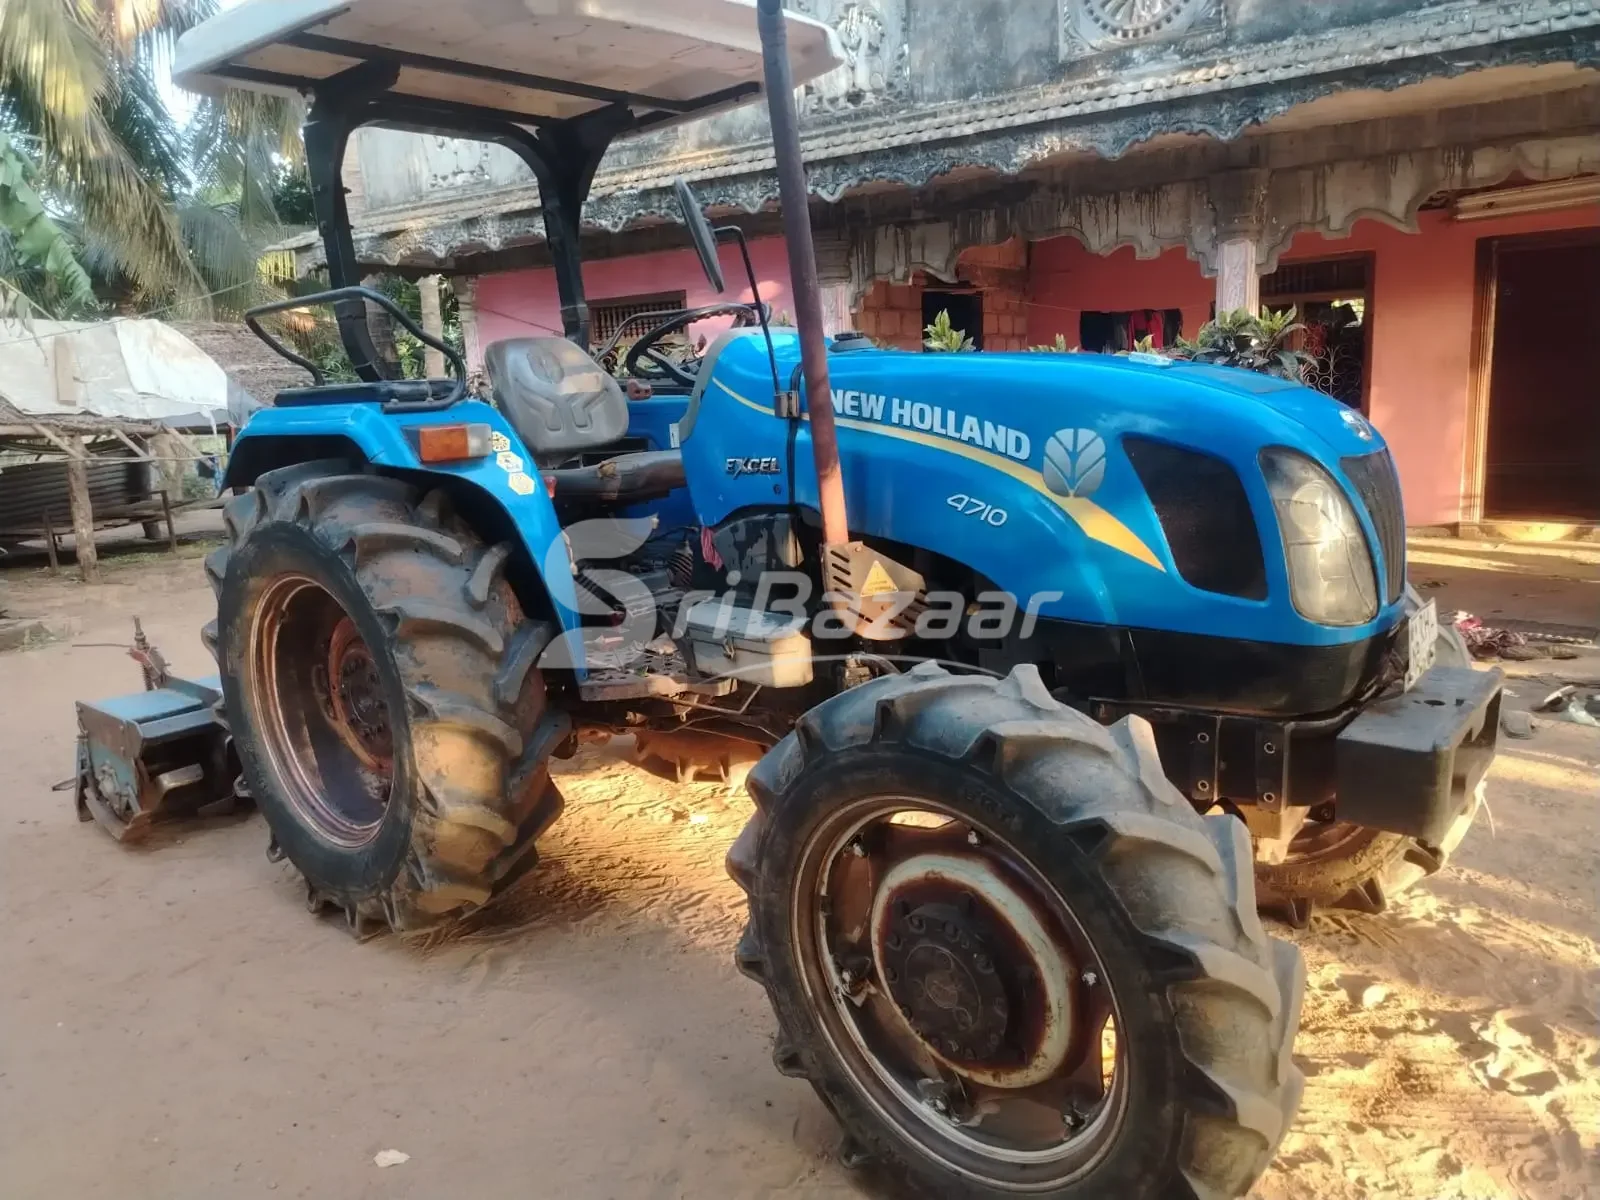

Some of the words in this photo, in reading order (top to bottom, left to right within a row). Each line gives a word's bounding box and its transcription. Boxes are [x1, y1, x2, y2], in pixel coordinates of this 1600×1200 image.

[830, 389, 886, 420] NEW
[891, 398, 1031, 461] HOLLAND
[726, 457, 780, 480] EXCEL
[947, 493, 1008, 526] 4710
